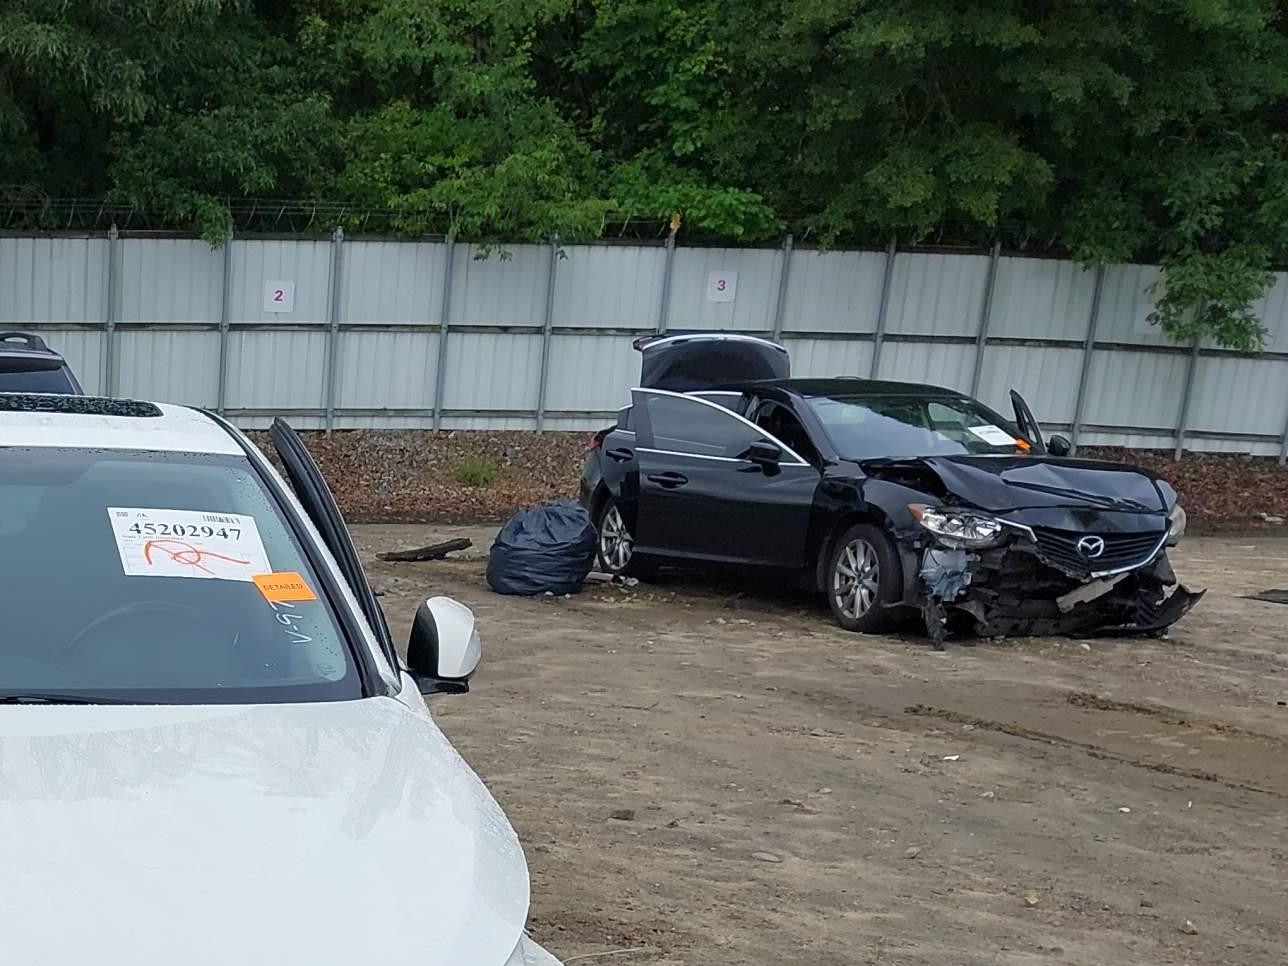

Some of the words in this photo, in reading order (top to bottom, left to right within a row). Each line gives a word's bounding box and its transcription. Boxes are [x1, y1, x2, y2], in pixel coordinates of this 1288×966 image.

[717, 279, 726, 291] 3
[273, 289, 284, 302] 2
[128, 522, 241, 541] 45202947
